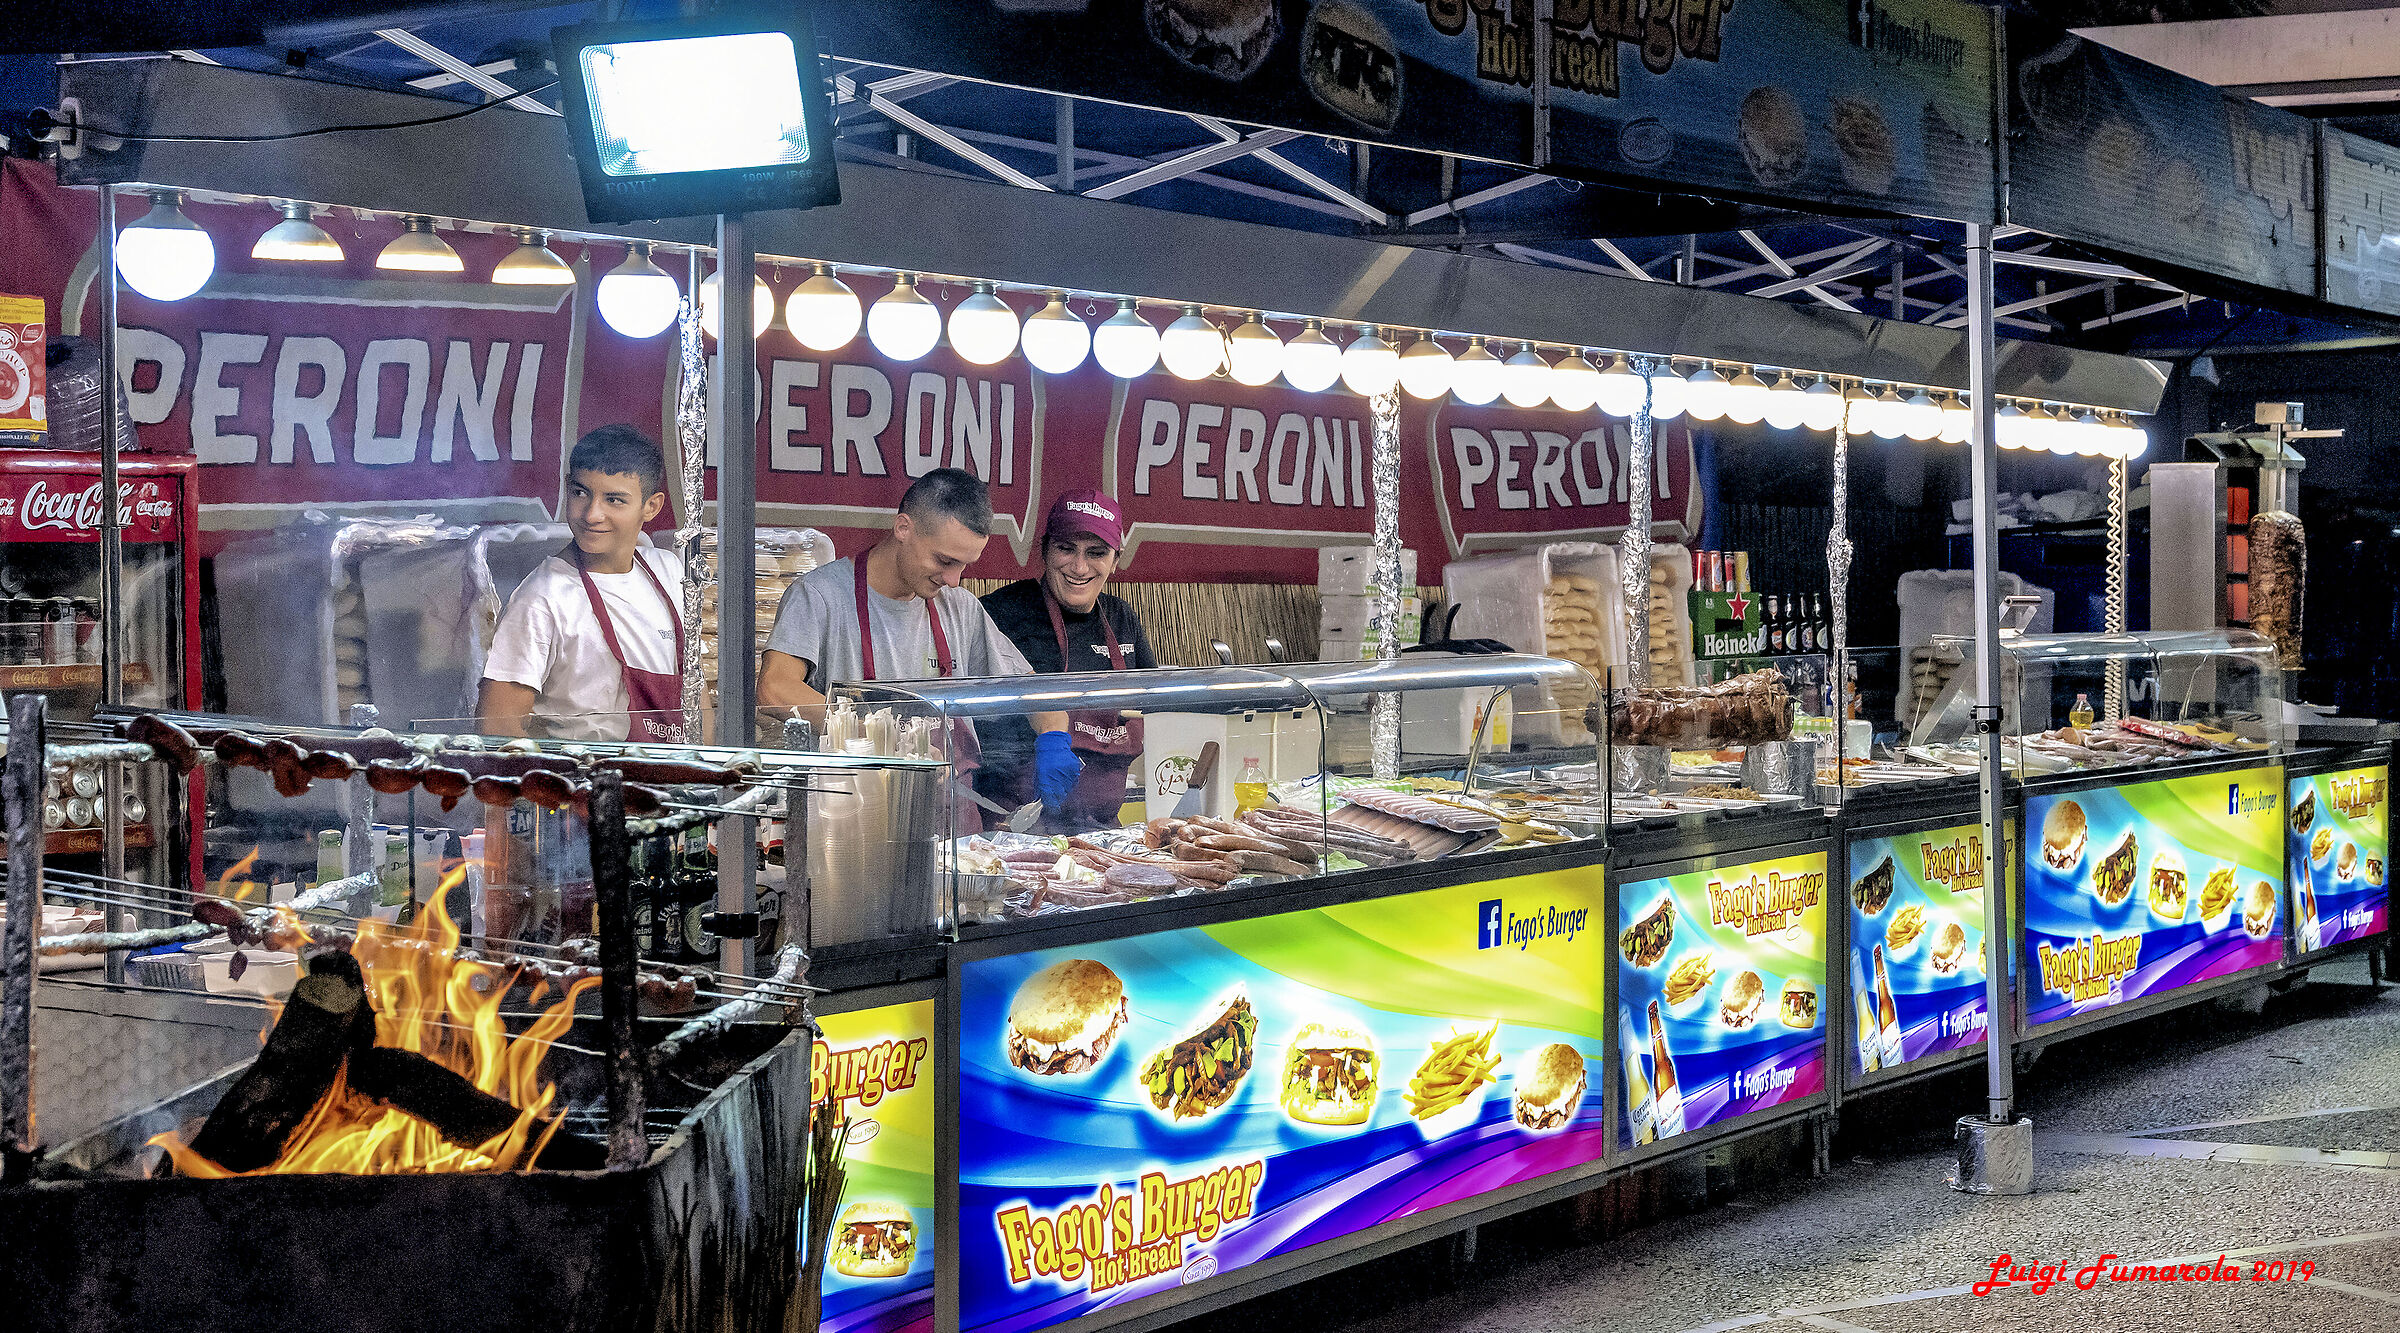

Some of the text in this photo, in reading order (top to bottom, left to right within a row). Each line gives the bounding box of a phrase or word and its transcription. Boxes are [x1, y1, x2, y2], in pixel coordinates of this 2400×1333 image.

[1478, 12, 1534, 87] Hot
[1549, 32, 1619, 98] read
[606, 178, 653, 196] FOYU
[117, 327, 543, 464] PERONI
[1134, 399, 1366, 507] PERONI
[1704, 632, 1759, 656] Heinek
[643, 718, 683, 738] Fago's
[1921, 838, 1966, 885] Fago's
[1952, 870, 1983, 893] Hot Bread
[1709, 872, 1823, 928] Fago's Burger
[1747, 914, 1762, 936] Hot
[1762, 910, 1786, 933] Bread
[1507, 908, 1545, 951] Fago's
[1547, 906, 1588, 942] Burger
[2039, 935, 2140, 994] Fago's Burger
[2074, 980, 2087, 1003] Hot
[2088, 975, 2108, 999] Bread
[1950, 1012, 1970, 1038] Fago's
[809, 1037, 928, 1107] Burger
[1744, 1071, 1770, 1100] Fago's
[1770, 1066, 1797, 1092] Burger
[997, 1160, 1262, 1284] Fago's Burger
[1091, 1237, 1181, 1294] Hot Bread
